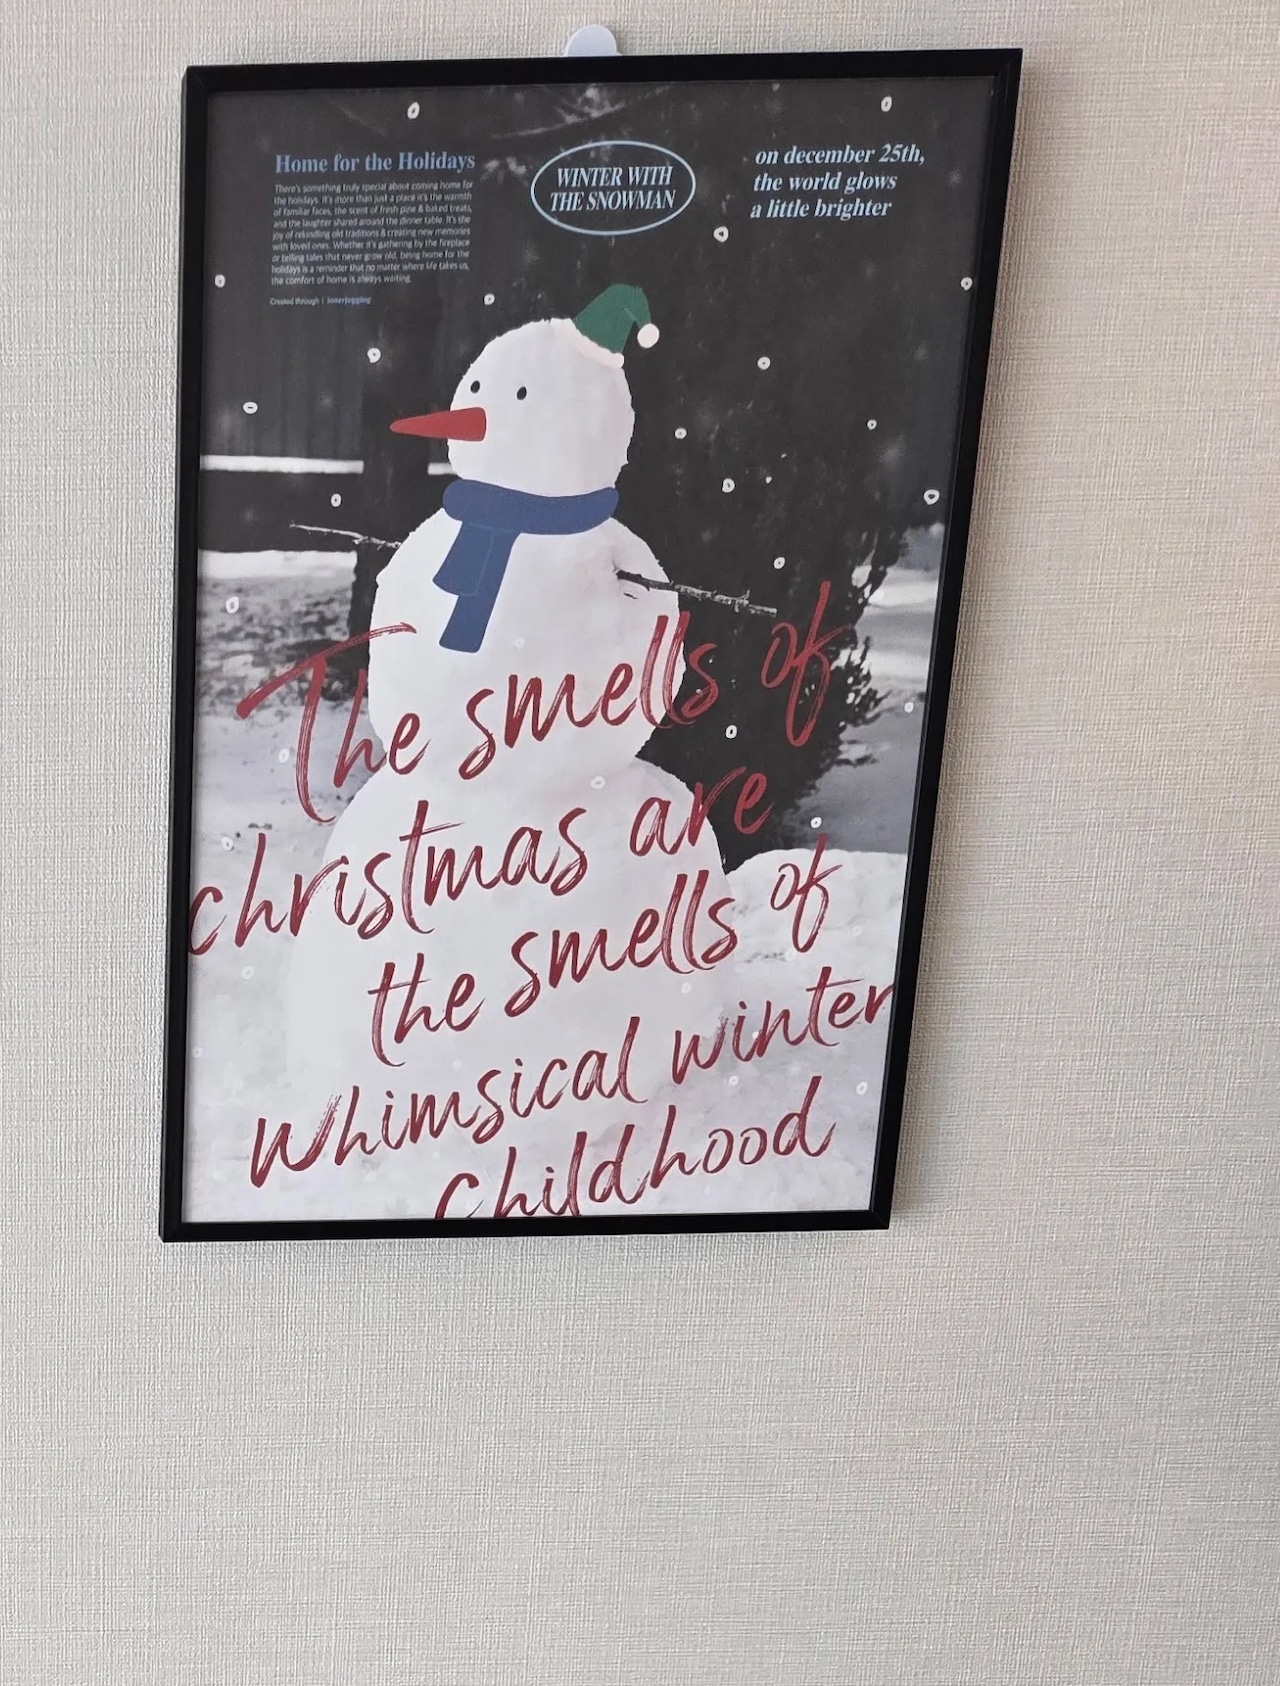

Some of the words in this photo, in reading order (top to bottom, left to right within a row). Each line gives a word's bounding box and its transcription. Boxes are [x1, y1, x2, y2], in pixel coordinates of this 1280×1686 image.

[275, 154, 328, 174] Home
[333, 153, 360, 172] for
[365, 152, 393, 172] the
[398, 151, 476, 174] Holidays
[754, 150, 778, 165] on
[783, 145, 875, 165] december
[878, 143, 926, 165] 25th,
[556, 167, 622, 188] WINTER
[627, 165, 674, 186] WITH
[753, 174, 785, 192] the
[788, 173, 842, 191] world
[844, 173, 897, 194] glows
[275, 184, 301, 193] There's
[303, 183, 341, 195] something
[343, 182, 360, 194] truly
[362, 182, 386, 194] special
[389, 181, 409, 191] about
[411, 180, 438, 192] coming
[440, 180, 460, 189] home
[463, 180, 473, 189] for
[274, 196, 287, 205] the
[335, 196, 354, 204] more
[356, 194, 373, 203] than
[373, 193, 387, 205] just
[396, 193, 416, 205] place
[430, 192, 443, 202] the
[444, 191, 472, 201] warmth
[550, 191, 583, 212] THE
[586, 189, 676, 211] SNOWMAN
[283, 207, 310, 216] familiar
[335, 206, 347, 215] the
[349, 205, 368, 215] scent
[380, 204, 399, 214] fresh
[400, 204, 416, 216] pine
[425, 203, 448, 213] baked
[750, 204, 763, 219] a
[766, 199, 810, 219] little
[814, 199, 893, 222] brighter
[273, 219, 287, 228] and
[289, 219, 300, 228] the
[303, 218, 331, 230] laughter
[333, 217, 357, 227] shared
[359, 217, 384, 226] around
[386, 216, 398, 225] the
[400, 216, 422, 225] dinner
[458, 215, 471, 224] the
[273, 231, 284, 242] joy
[332, 229, 343, 238] old
[345, 228, 379, 238] traditions
[387, 227, 416, 239] creating
[435, 226, 470, 236] memories
[272, 242, 288, 251] with
[290, 241, 310, 251] loved
[333, 240, 364, 250] Whether
[378, 239, 413, 251] gathering
[425, 238, 437, 247] the
[439, 238, 470, 250] fireplace
[282, 253, 304, 265] telling
[306, 253, 323, 262] tales
[325, 252, 340, 261] that
[364, 253, 382, 263] grow
[400, 250, 420, 262] being
[422, 250, 443, 259] home
[444, 249, 454, 259] for
[457, 249, 469, 258] the
[271, 264, 300, 277] holidays
[316, 263, 347, 273] reminder
[349, 263, 364, 272] that
[377, 262, 400, 272] matter
[402, 261, 424, 271] where
[426, 261, 437, 271] life
[439, 261, 457, 270] takes
[271, 276, 284, 285] the
[285, 275, 315, 285] comfort
[326, 275, 347, 284] home
[357, 274, 382, 286] always
[270, 297, 294, 306] Created
[295, 296, 319, 308] through
[236, 621, 429, 823] The
[458, 611, 719, 780] smells
[760, 580, 856, 747] of
[629, 765, 771, 857] are
[366, 951, 487, 1067] the
[504, 868, 738, 1016] smells
[768, 832, 846, 954] of
[670, 965, 894, 1085] winter
